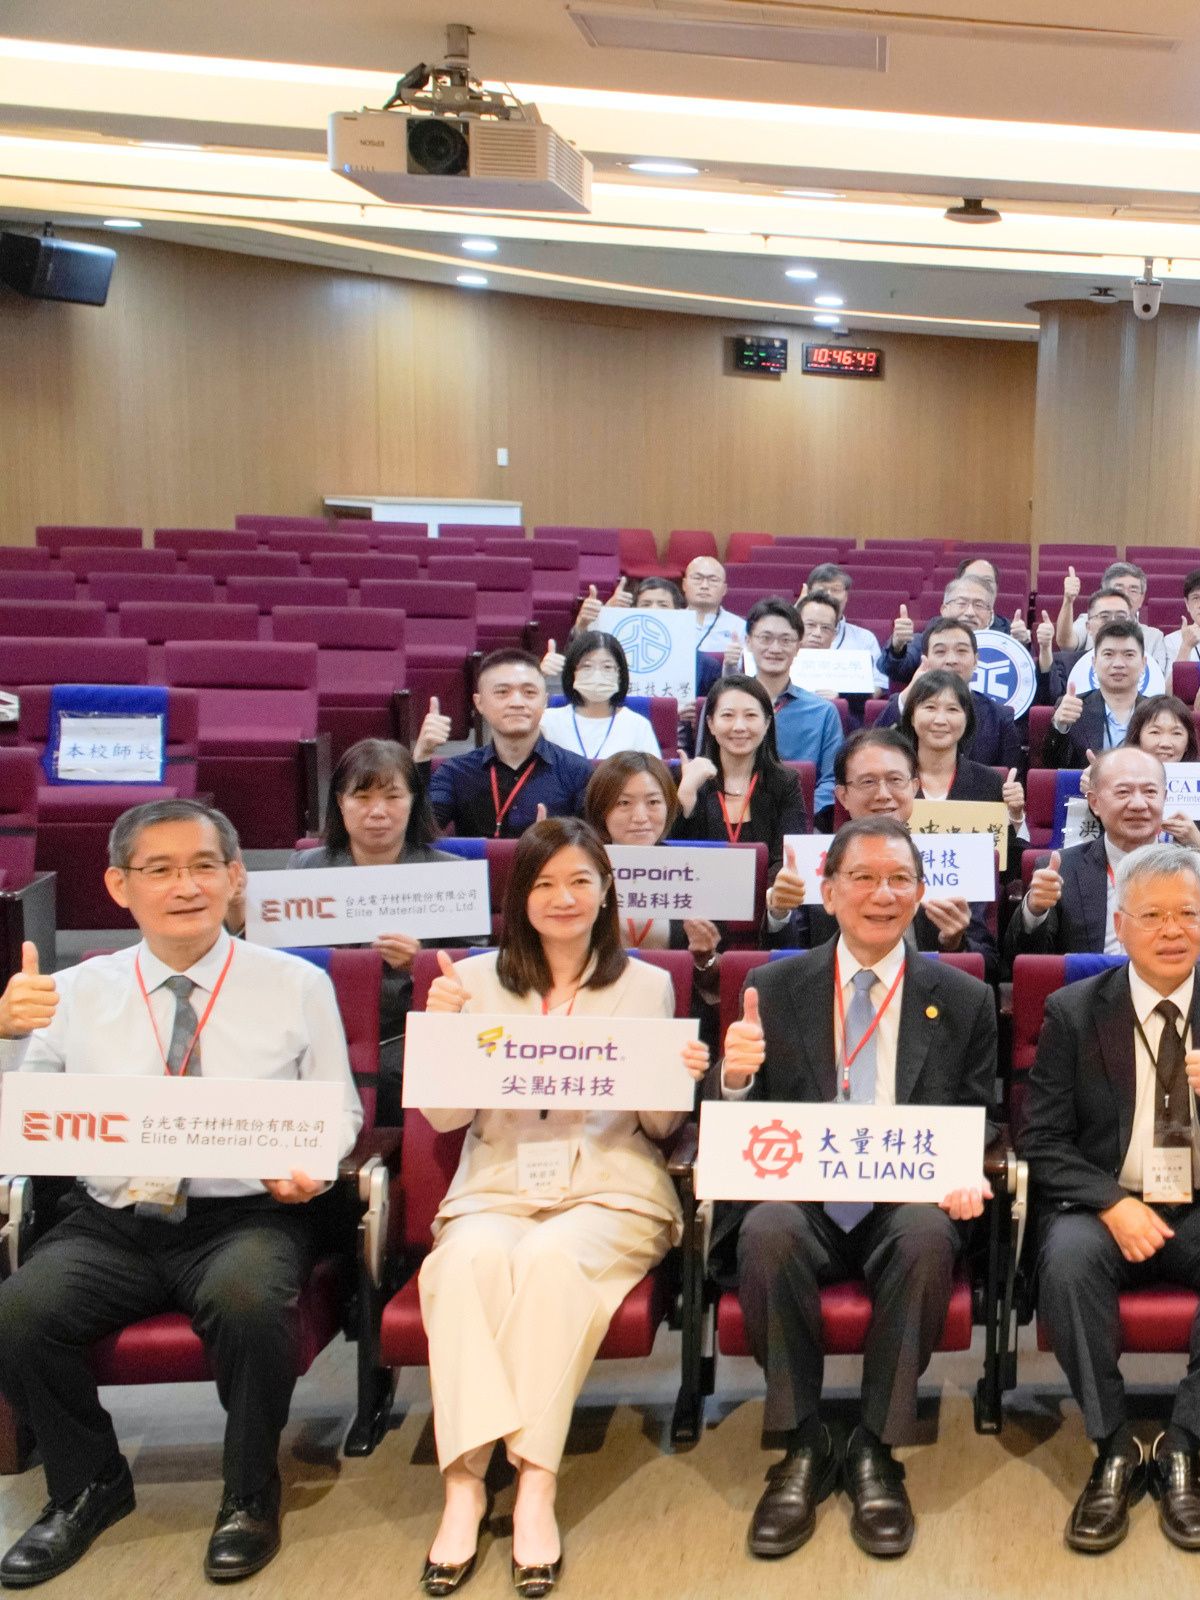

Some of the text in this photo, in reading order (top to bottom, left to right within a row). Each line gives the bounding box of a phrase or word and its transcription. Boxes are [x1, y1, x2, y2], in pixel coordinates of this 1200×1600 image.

[813, 348, 877, 366] 10:46:49
[66, 744, 156, 759] 本校師長
[1168, 780, 1191, 793] CA
[920, 849, 960, 869] 科技
[923, 872, 959, 886] ANG
[261, 889, 478, 922] EMC 台光電子材料股份有限公司
[346, 908, 372, 918] Elite
[379, 905, 426, 916] Material
[501, 1076, 615, 1096] 尖點科技
[22, 1110, 325, 1143] EMC 台光電子材料股份有限公司
[141, 1133, 177, 1145] Elite
[187, 1134, 252, 1147] Material
[294, 1136, 322, 1148] Ltd.
[819, 1128, 937, 1157] 大量科技
[819, 1160, 935, 1180] TA LIANG
